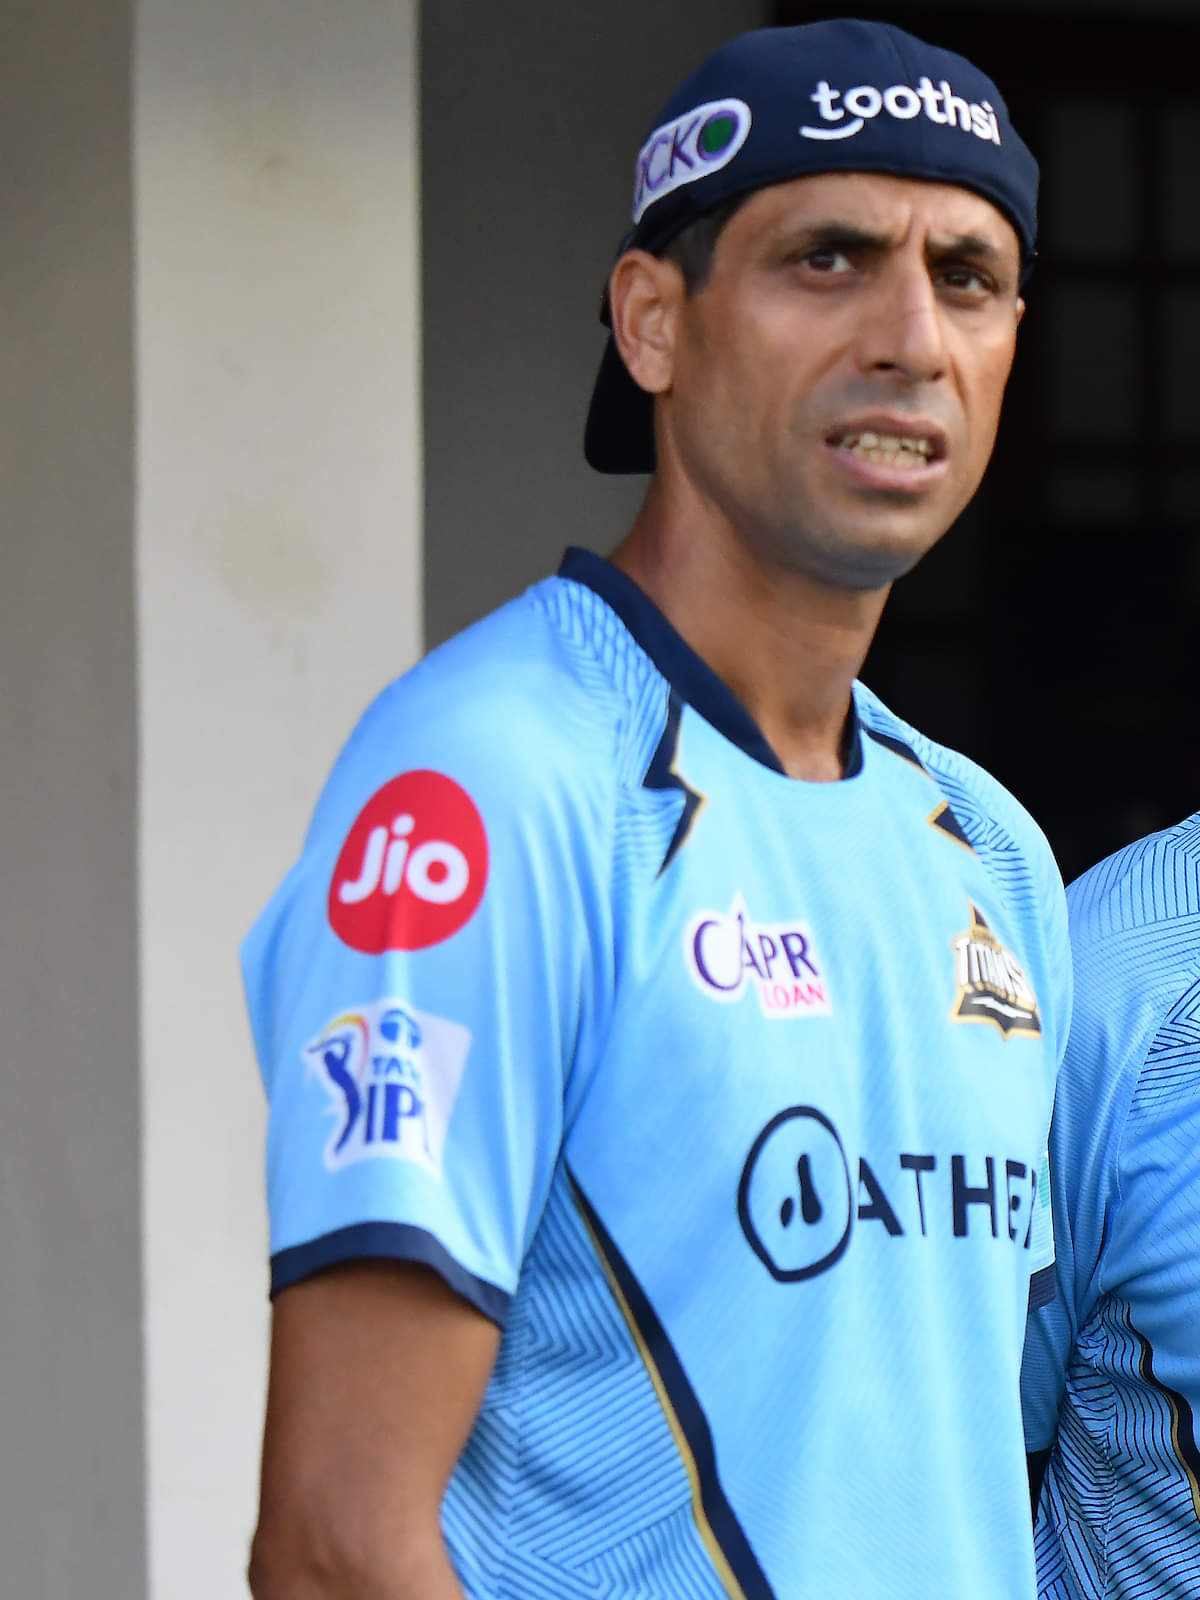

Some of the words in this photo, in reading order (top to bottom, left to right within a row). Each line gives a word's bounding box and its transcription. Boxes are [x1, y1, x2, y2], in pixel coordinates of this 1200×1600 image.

[809, 76, 1001, 146] toothsi
[338, 813, 470, 904] Jio
[692, 911, 821, 992] CAPR
[762, 983, 827, 1009] LOAN
[364, 1083, 427, 1147] IP
